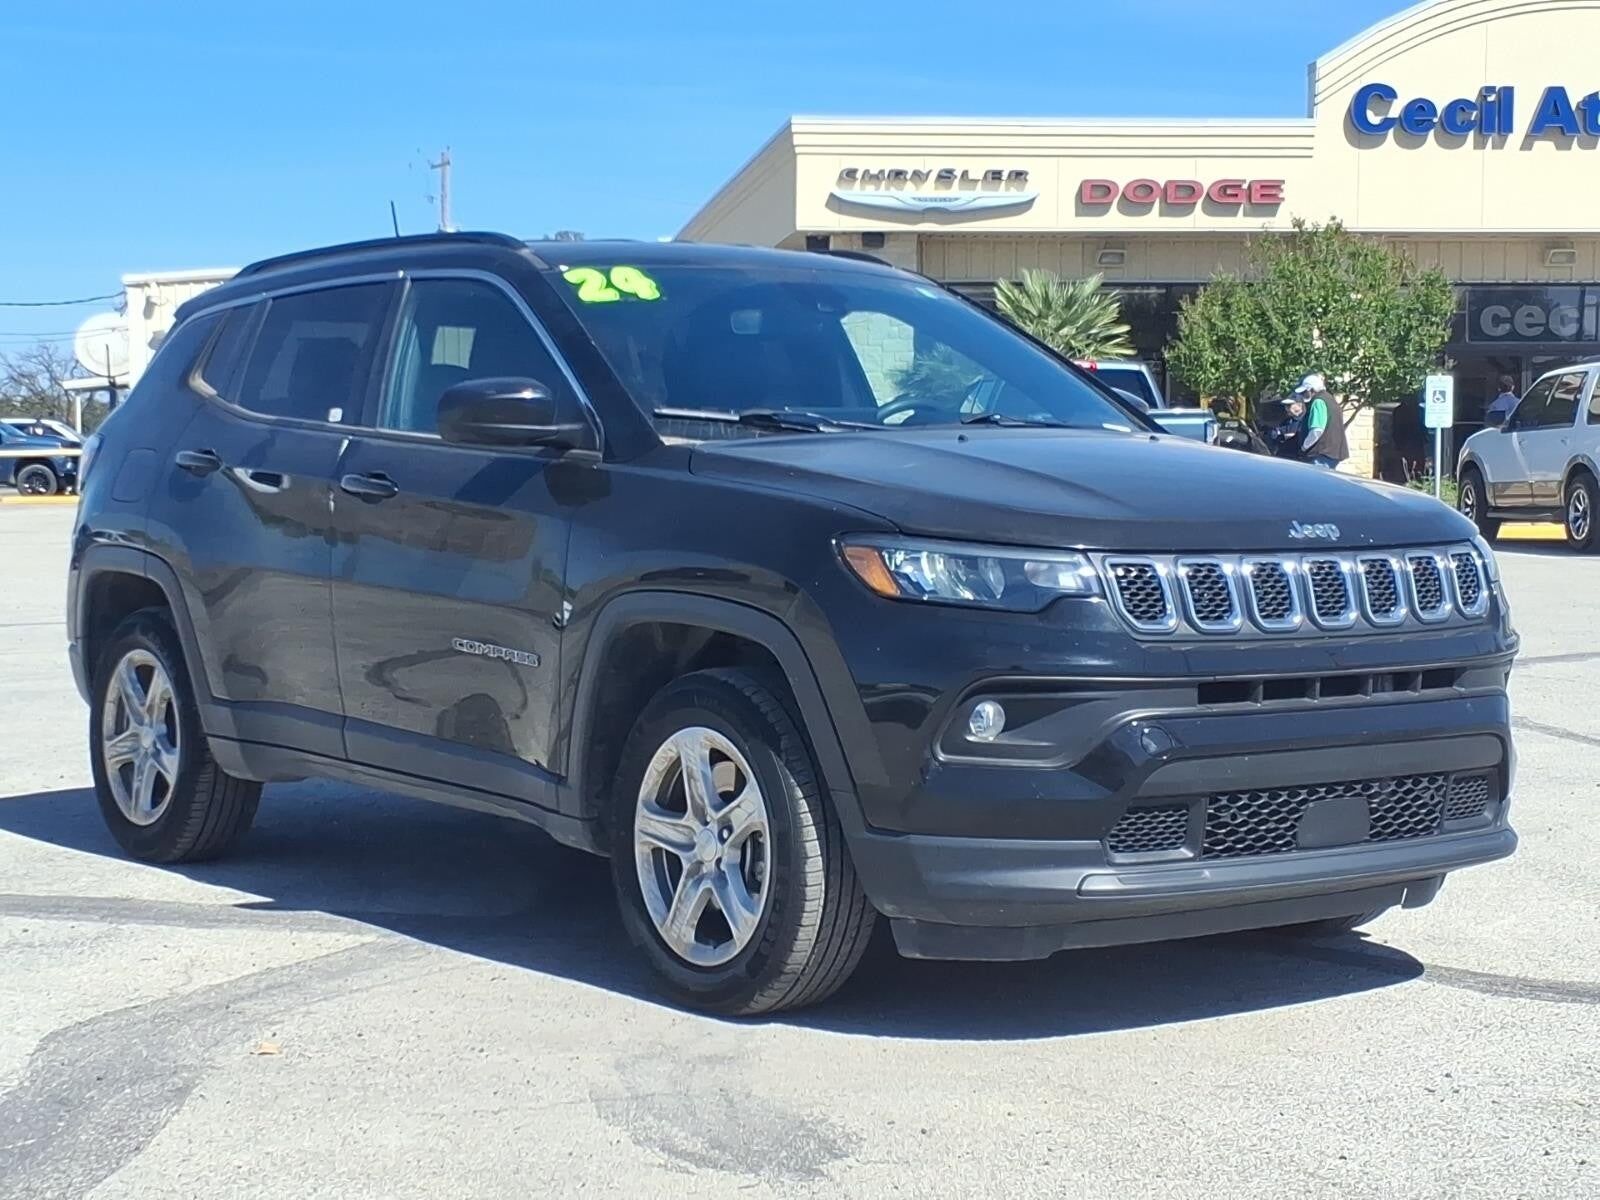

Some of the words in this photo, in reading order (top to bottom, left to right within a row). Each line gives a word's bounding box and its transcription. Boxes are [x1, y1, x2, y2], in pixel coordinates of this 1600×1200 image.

[1349, 82, 1515, 138] Cecil
[838, 167, 1030, 186] CHRYSLER
[1079, 178, 1286, 205] DODGE
[1288, 520, 1341, 541] Jeep
[452, 637, 540, 667] COMPASS
